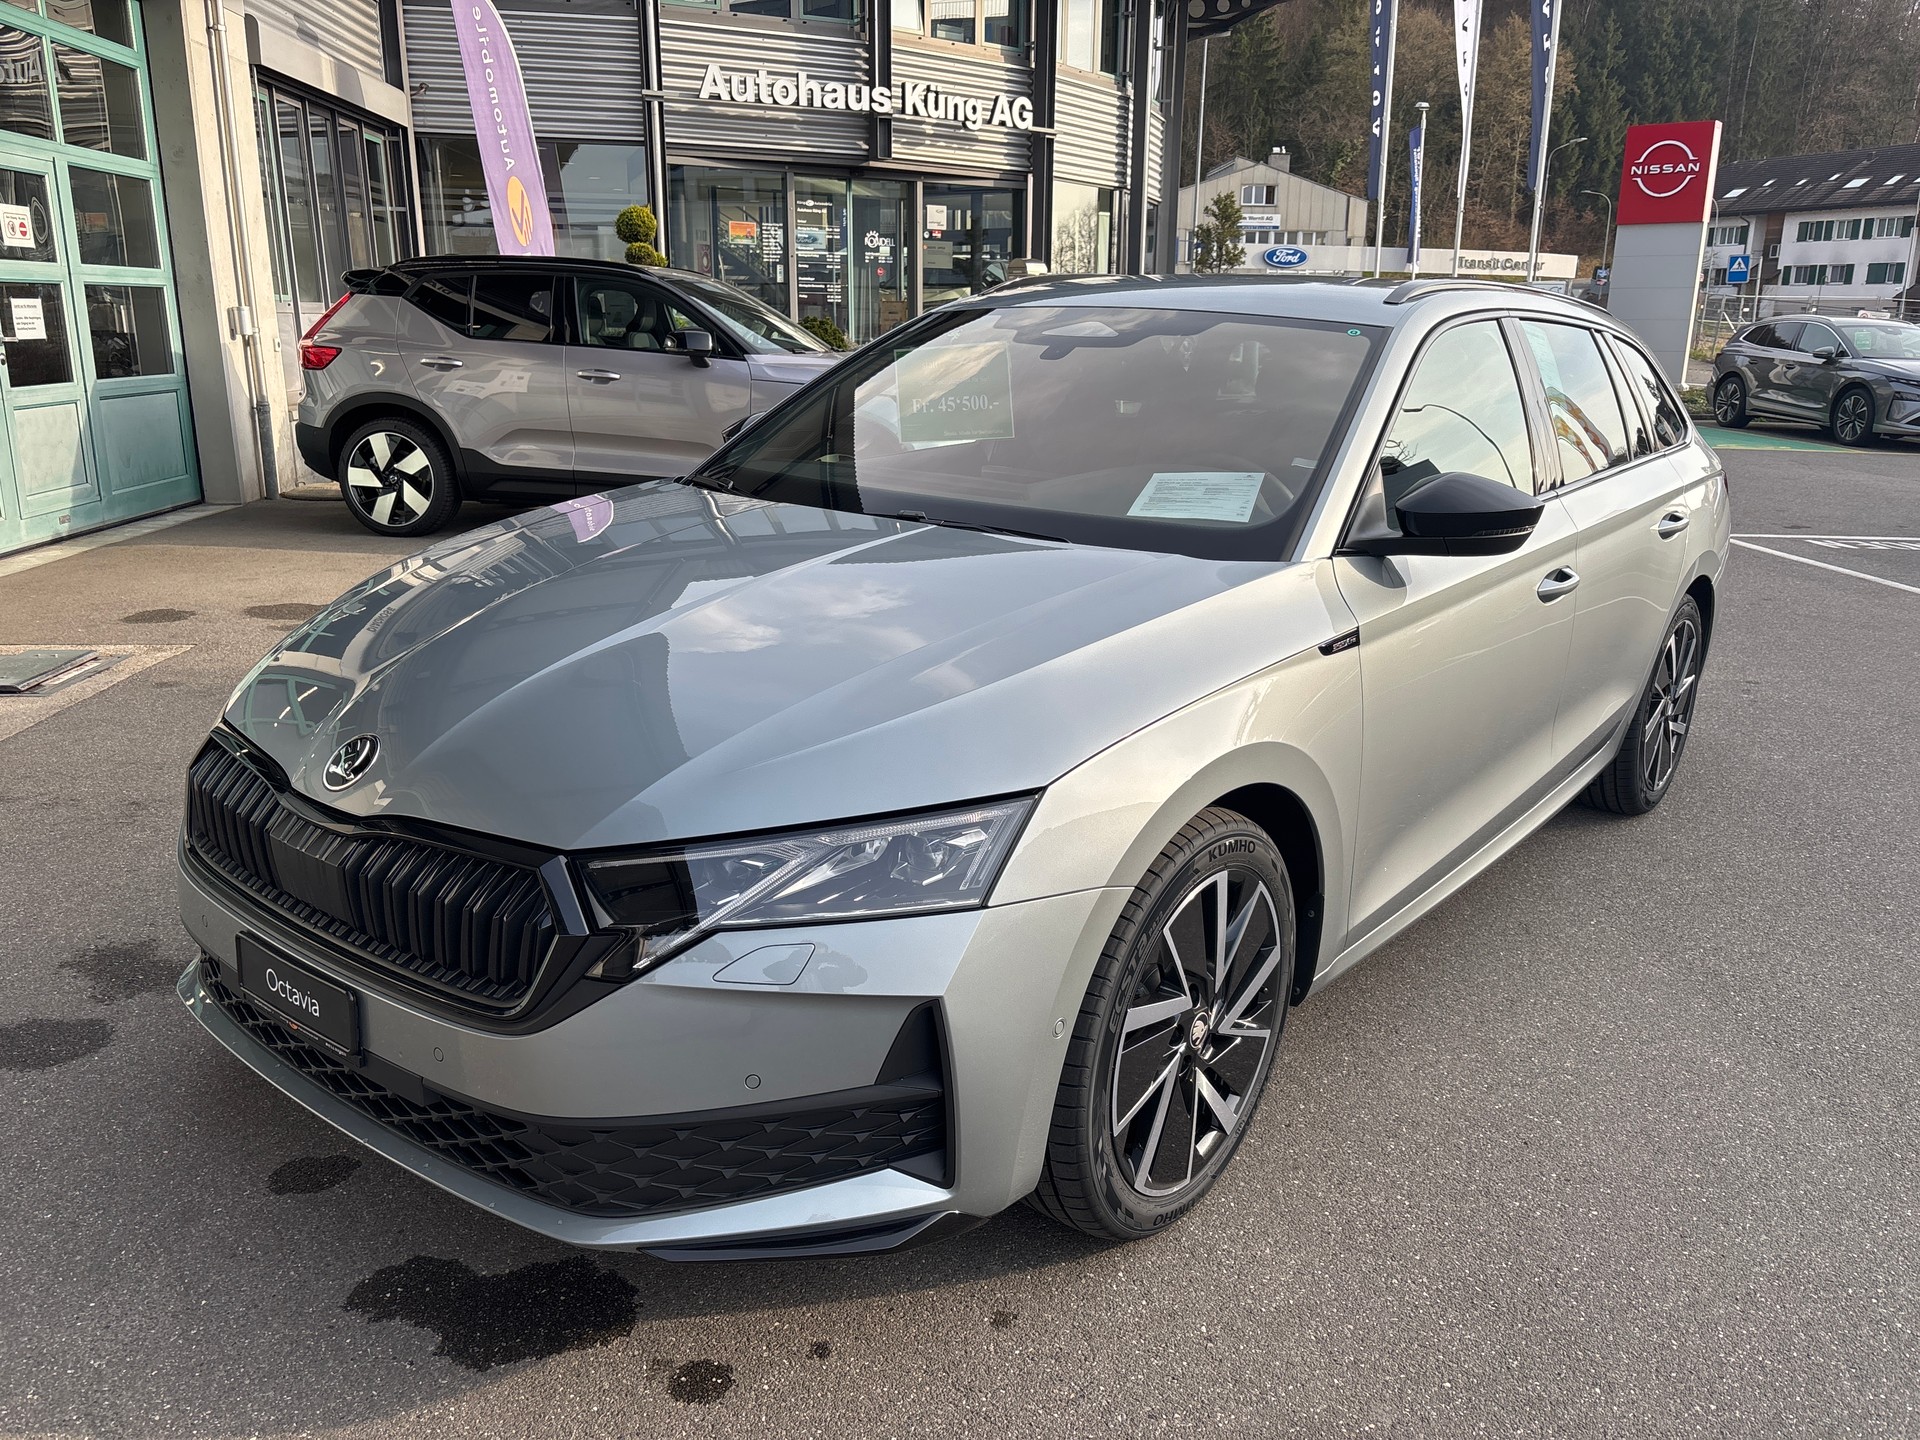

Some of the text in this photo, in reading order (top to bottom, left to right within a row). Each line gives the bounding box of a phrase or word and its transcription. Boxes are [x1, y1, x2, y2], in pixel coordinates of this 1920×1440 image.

[698, 63, 1034, 130] Autohaus Küng AG
[1630, 162, 1701, 175] NISSAN
[1272, 249, 1301, 263] Ford
[1458, 256, 1501, 270] Transit
[911, 398, 934, 414] Fr.
[1207, 839, 1256, 863] KUMHO
[265, 968, 320, 1018] Octavia
